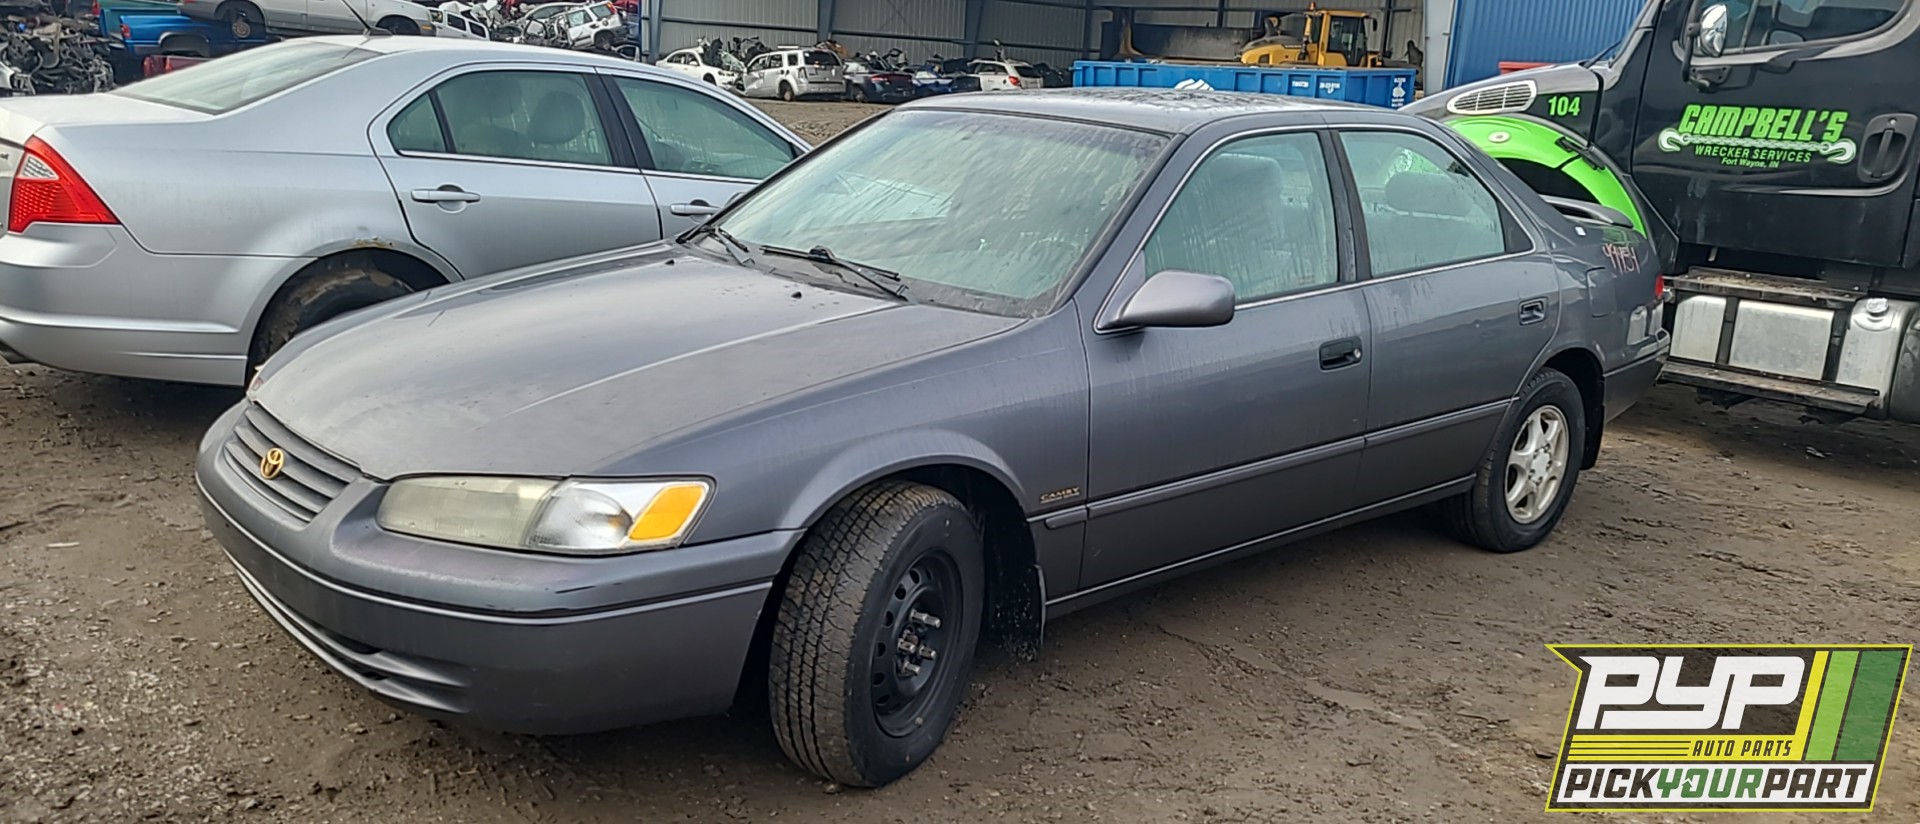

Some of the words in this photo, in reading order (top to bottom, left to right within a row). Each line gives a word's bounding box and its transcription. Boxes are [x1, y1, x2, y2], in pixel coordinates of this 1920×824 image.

[1548, 96, 1581, 116] 104
[1678, 104, 1849, 142] CAMPBELL'S
[1695, 145, 1750, 158] WRECKER
[1752, 148, 1812, 163] SERVICES
[1721, 157, 1738, 165] Fort
